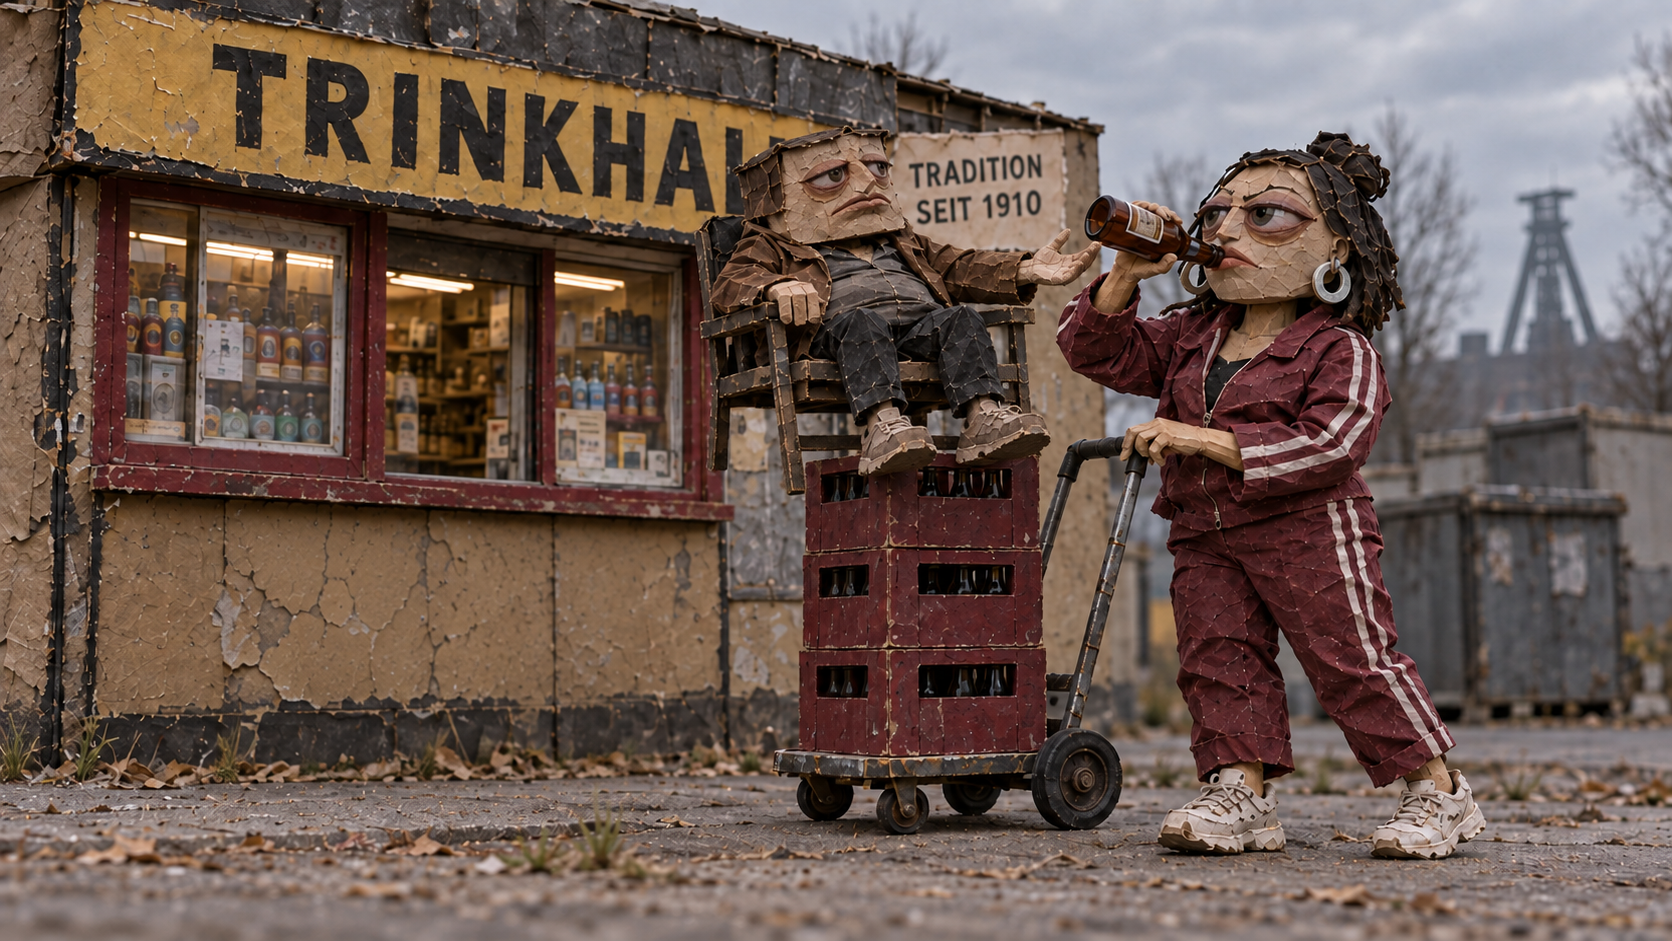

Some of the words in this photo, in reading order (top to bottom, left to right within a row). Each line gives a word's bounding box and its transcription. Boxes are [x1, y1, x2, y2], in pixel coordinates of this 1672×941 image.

[212, 43, 785, 215] TRINKHAL
[909, 154, 1042, 189] TRADITION
[917, 196, 972, 225] SEIT
[982, 190, 1042, 219] 1910
